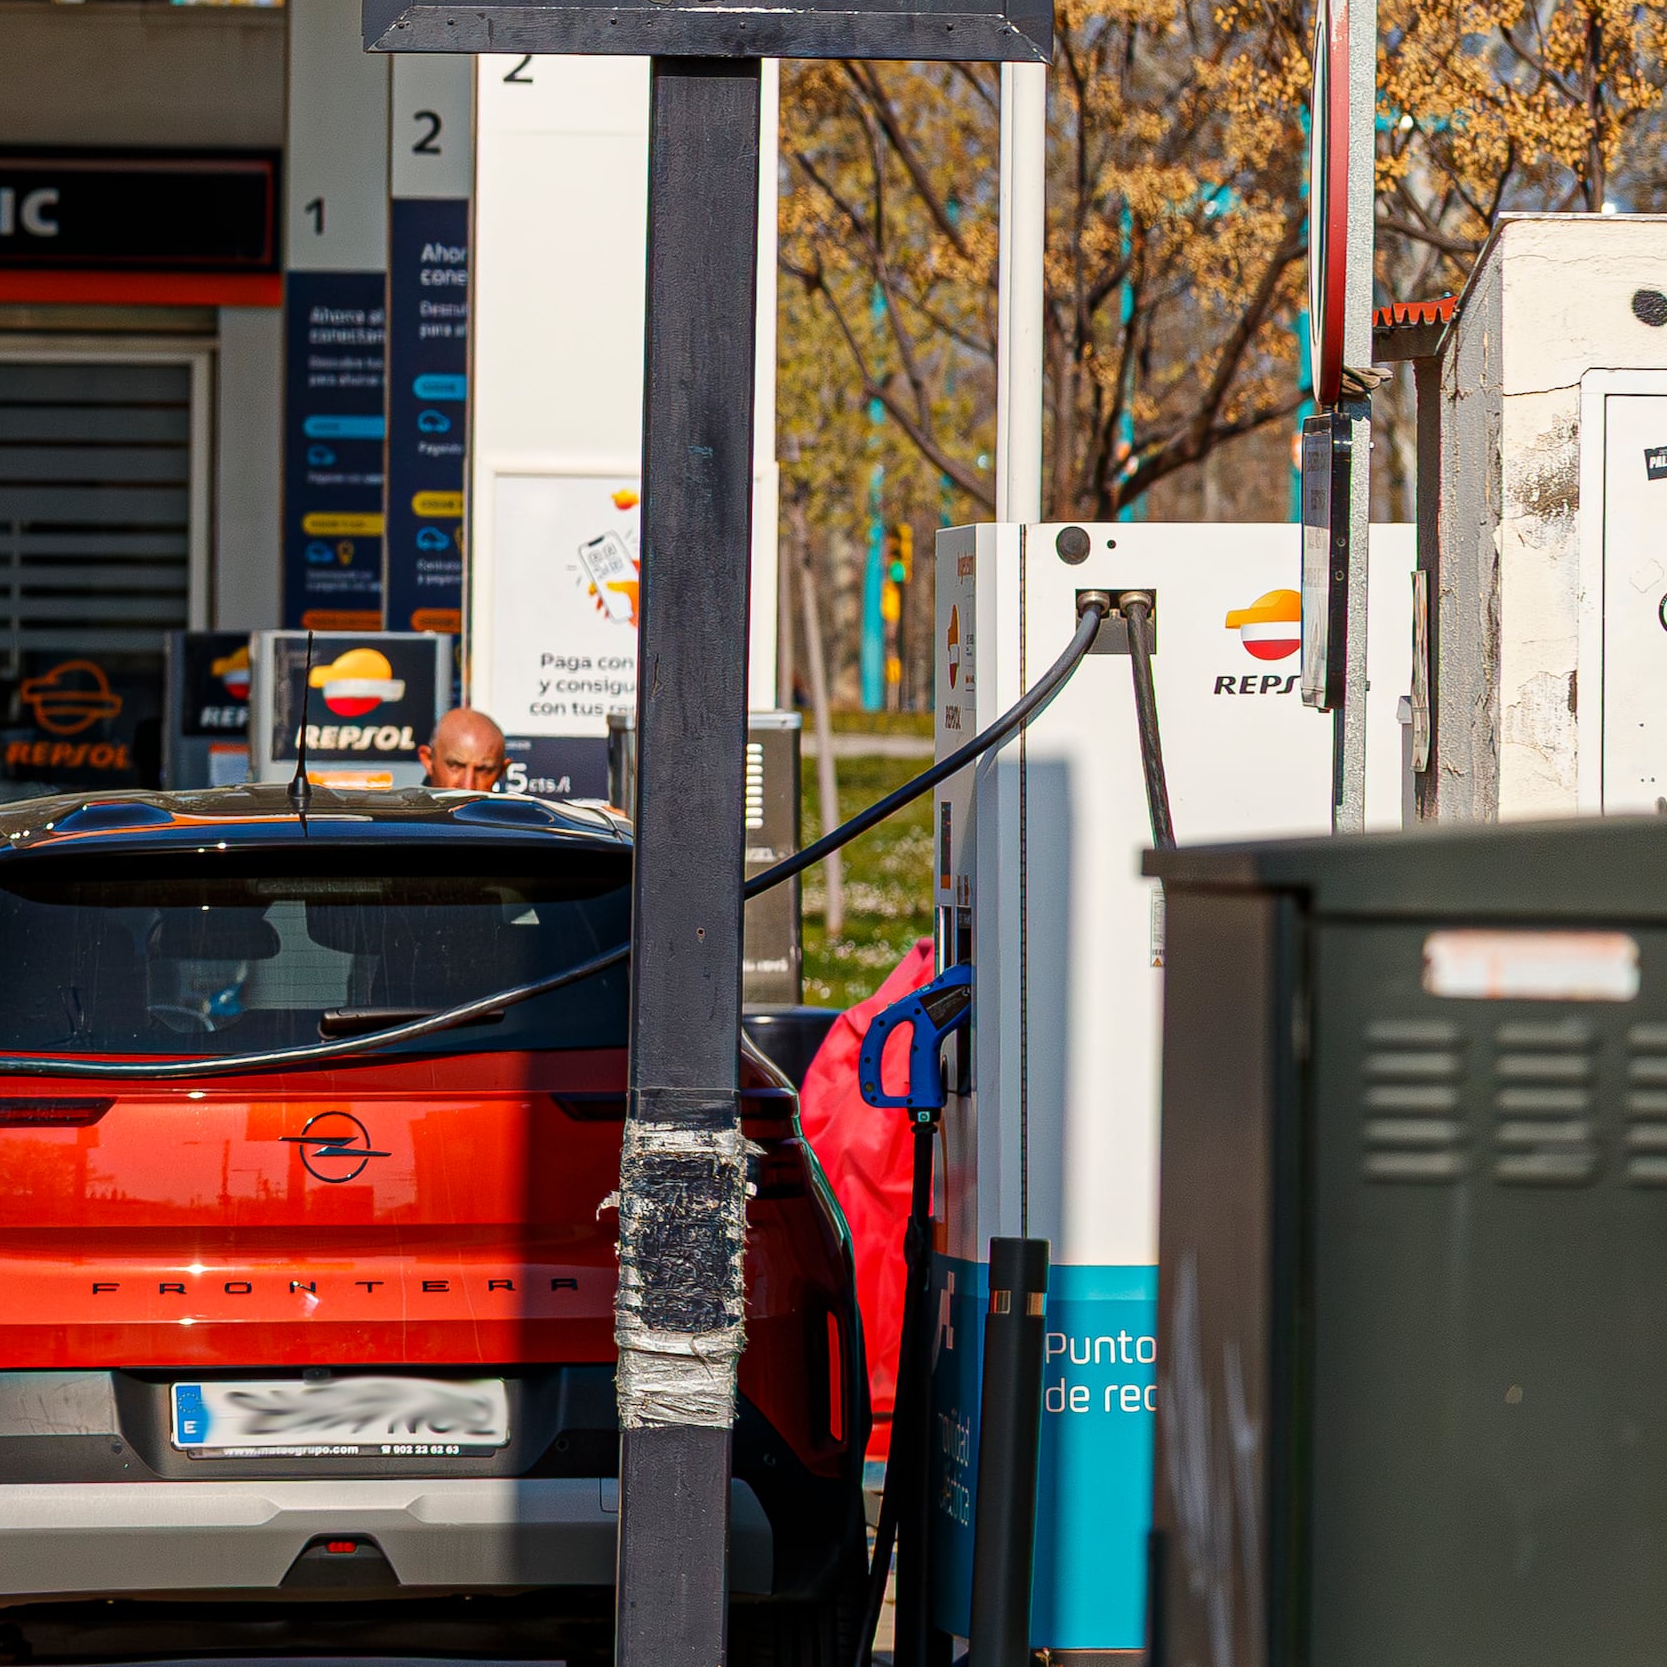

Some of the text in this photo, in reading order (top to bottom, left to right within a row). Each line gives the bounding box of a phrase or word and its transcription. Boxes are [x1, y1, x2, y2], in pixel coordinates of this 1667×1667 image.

[411, 110, 443, 155] 2
[304, 197, 325, 236] 1
[540, 652, 634, 672] Paga con
[539, 679, 551, 695] y
[1213, 675, 1301, 695] REPS
[530, 702, 566, 716] con
[572, 701, 604, 715] tus
[295, 725, 415, 750] REPSOL
[5, 740, 131, 770] REPSOL
[92, 1277, 579, 1295] FRONTERA
[1045, 1330, 1157, 1364] Punto
[1045, 1377, 1090, 1413] de
[183, 1420, 197, 1434] E
